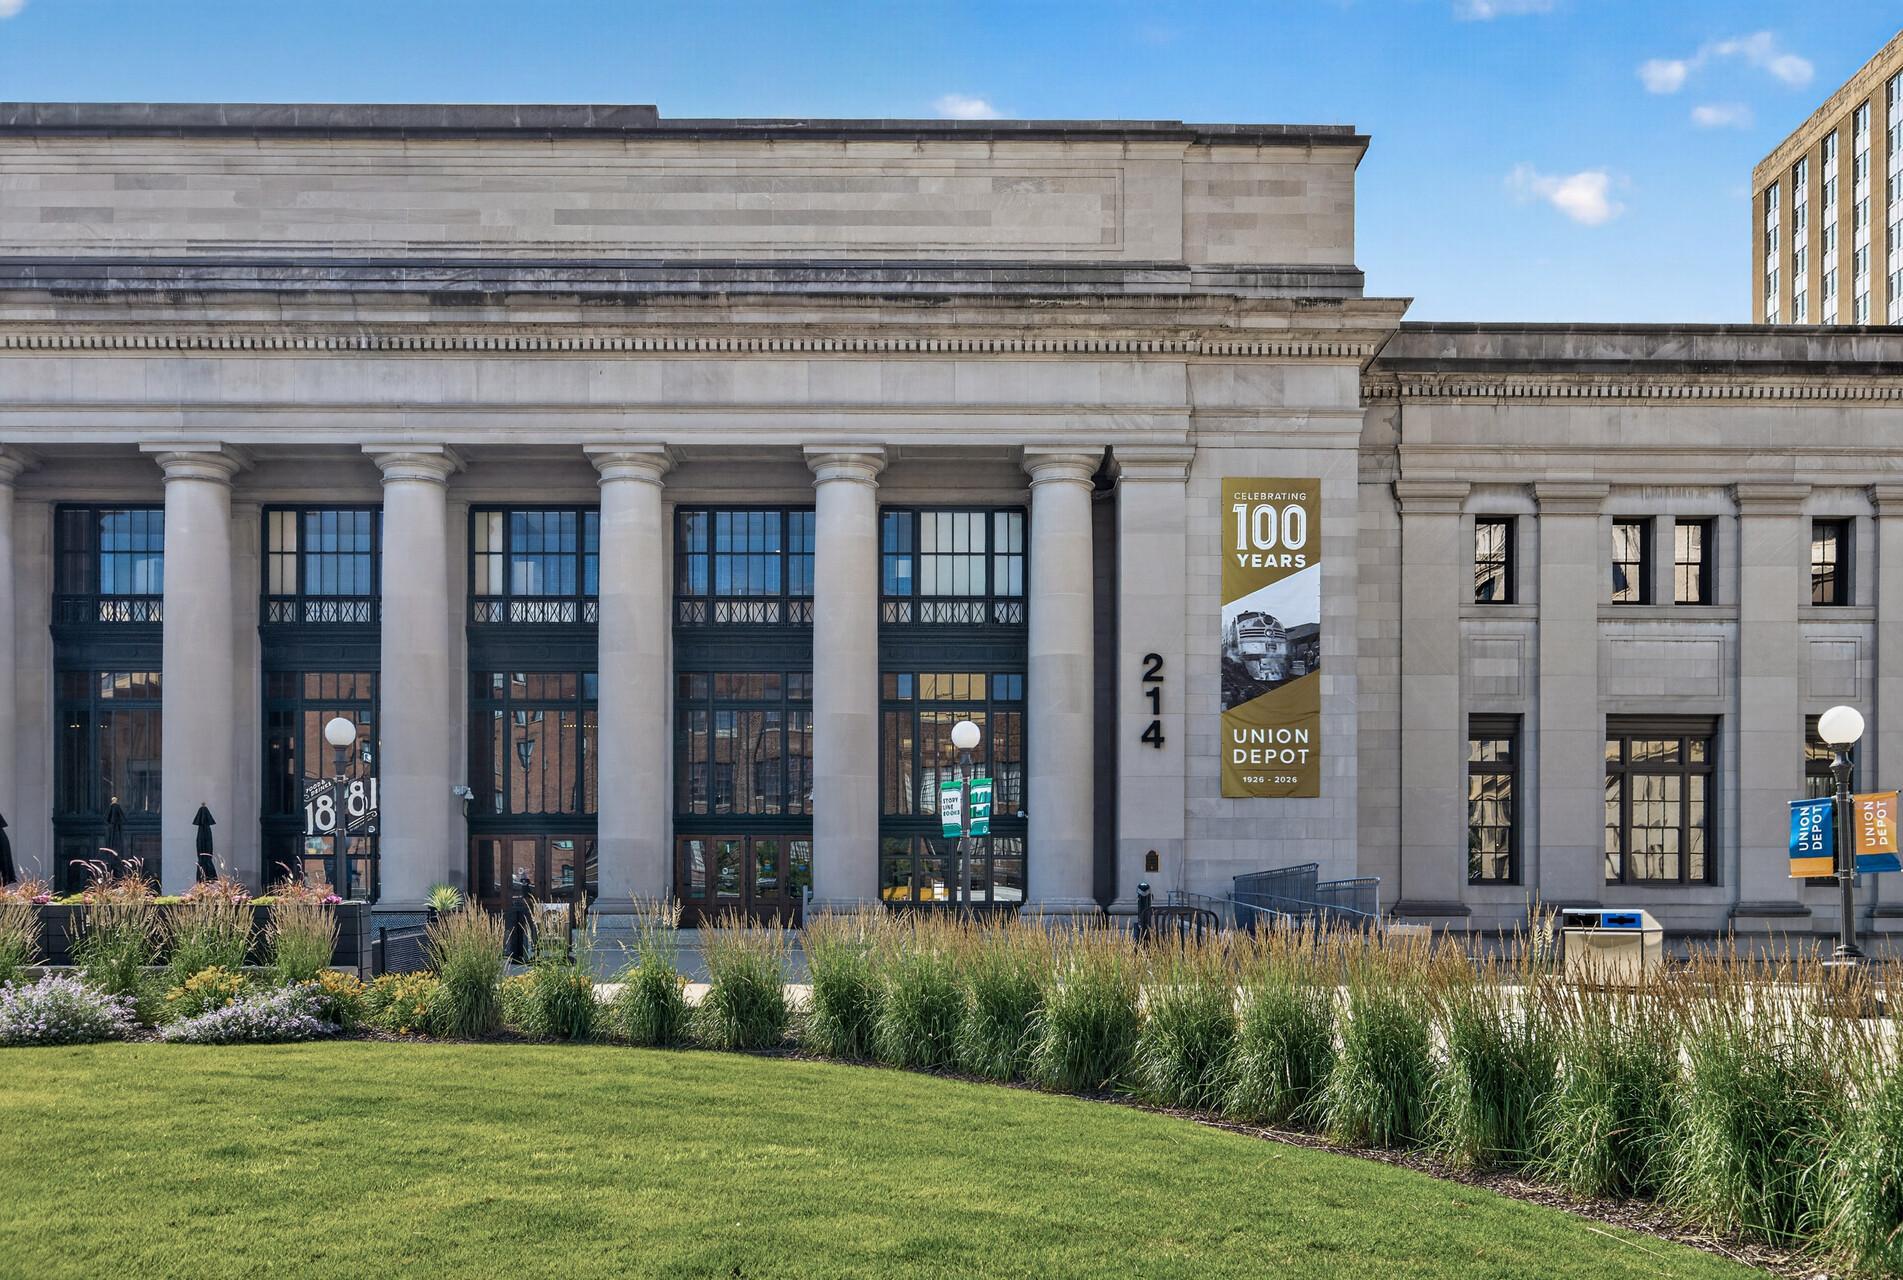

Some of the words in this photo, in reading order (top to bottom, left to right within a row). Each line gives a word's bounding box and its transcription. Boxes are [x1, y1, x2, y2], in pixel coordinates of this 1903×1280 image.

[1233, 492, 1307, 501] CELEBRATING
[1232, 503, 1307, 550] 100
[1236, 553, 1306, 568] YEARS
[1141, 653, 1165, 749] 214
[1233, 728, 1309, 744] UNION
[1233, 748, 1310, 764] DEPOT
[304, 795, 336, 835] 18
[348, 777, 378, 817] 81
[1798, 807, 1810, 851] UNION
[1812, 806, 1823, 850] DEPOT
[1863, 801, 1876, 847] UNION
[1876, 801, 1888, 845] DEPOT
